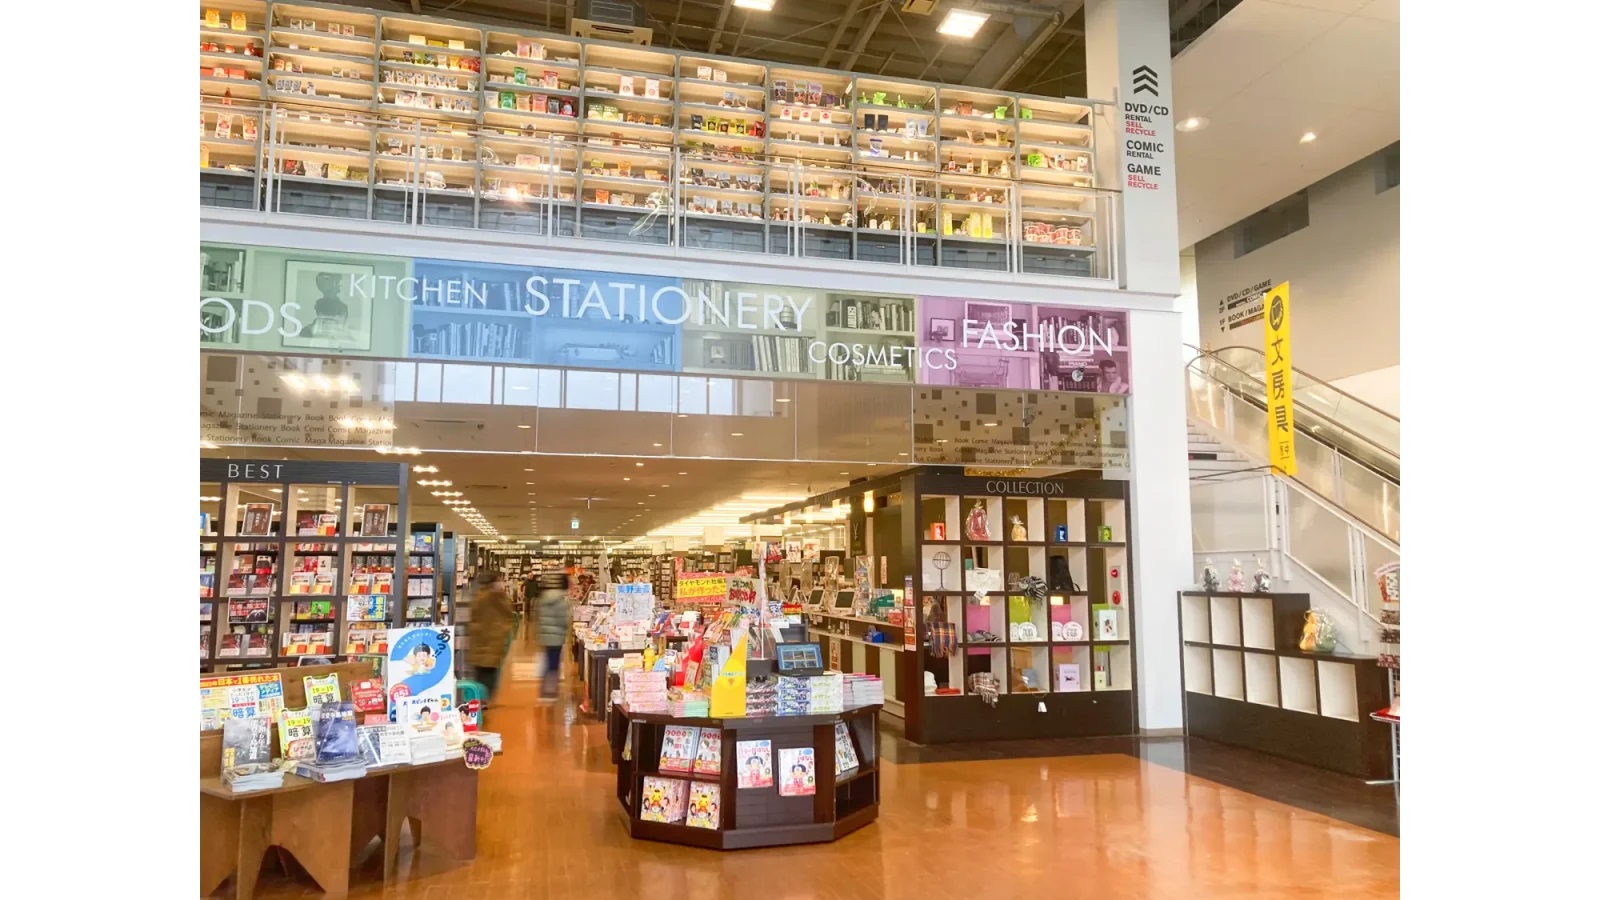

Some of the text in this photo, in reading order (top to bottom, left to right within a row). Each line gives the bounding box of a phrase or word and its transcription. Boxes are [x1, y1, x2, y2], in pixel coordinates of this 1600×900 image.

[1124, 102, 1169, 116] DVD/CD
[1125, 113, 1153, 123] RENTAL
[1125, 121, 1143, 129] SELL
[1125, 127, 1156, 137] RECYCLE
[1126, 140, 1165, 153] COMIC
[1126, 150, 1154, 160] RENTAL
[1127, 163, 1162, 176] GAME
[1128, 174, 1146, 182] SELL
[1128, 181, 1159, 190] RECYCLE
[349, 273, 488, 308] KITCHEN
[524, 275, 813, 333] STATIONERY
[962, 319, 1113, 357] FASHION
[808, 340, 958, 371] COSMETICS
[1271, 335, 1289, 433] 文房具
[236, 423, 277, 433] Stationery
[280, 424, 301, 432] Book
[355, 427, 392, 436] Magazine
[206, 433, 248, 443] Stationery
[251, 435, 273, 443] Book
[275, 436, 301, 444] Comic
[1004, 448, 1033, 457] Stationery
[984, 457, 1014, 465] Stationery
[227, 463, 284, 479] BEST
[986, 480, 1064, 495] COLLECTION
